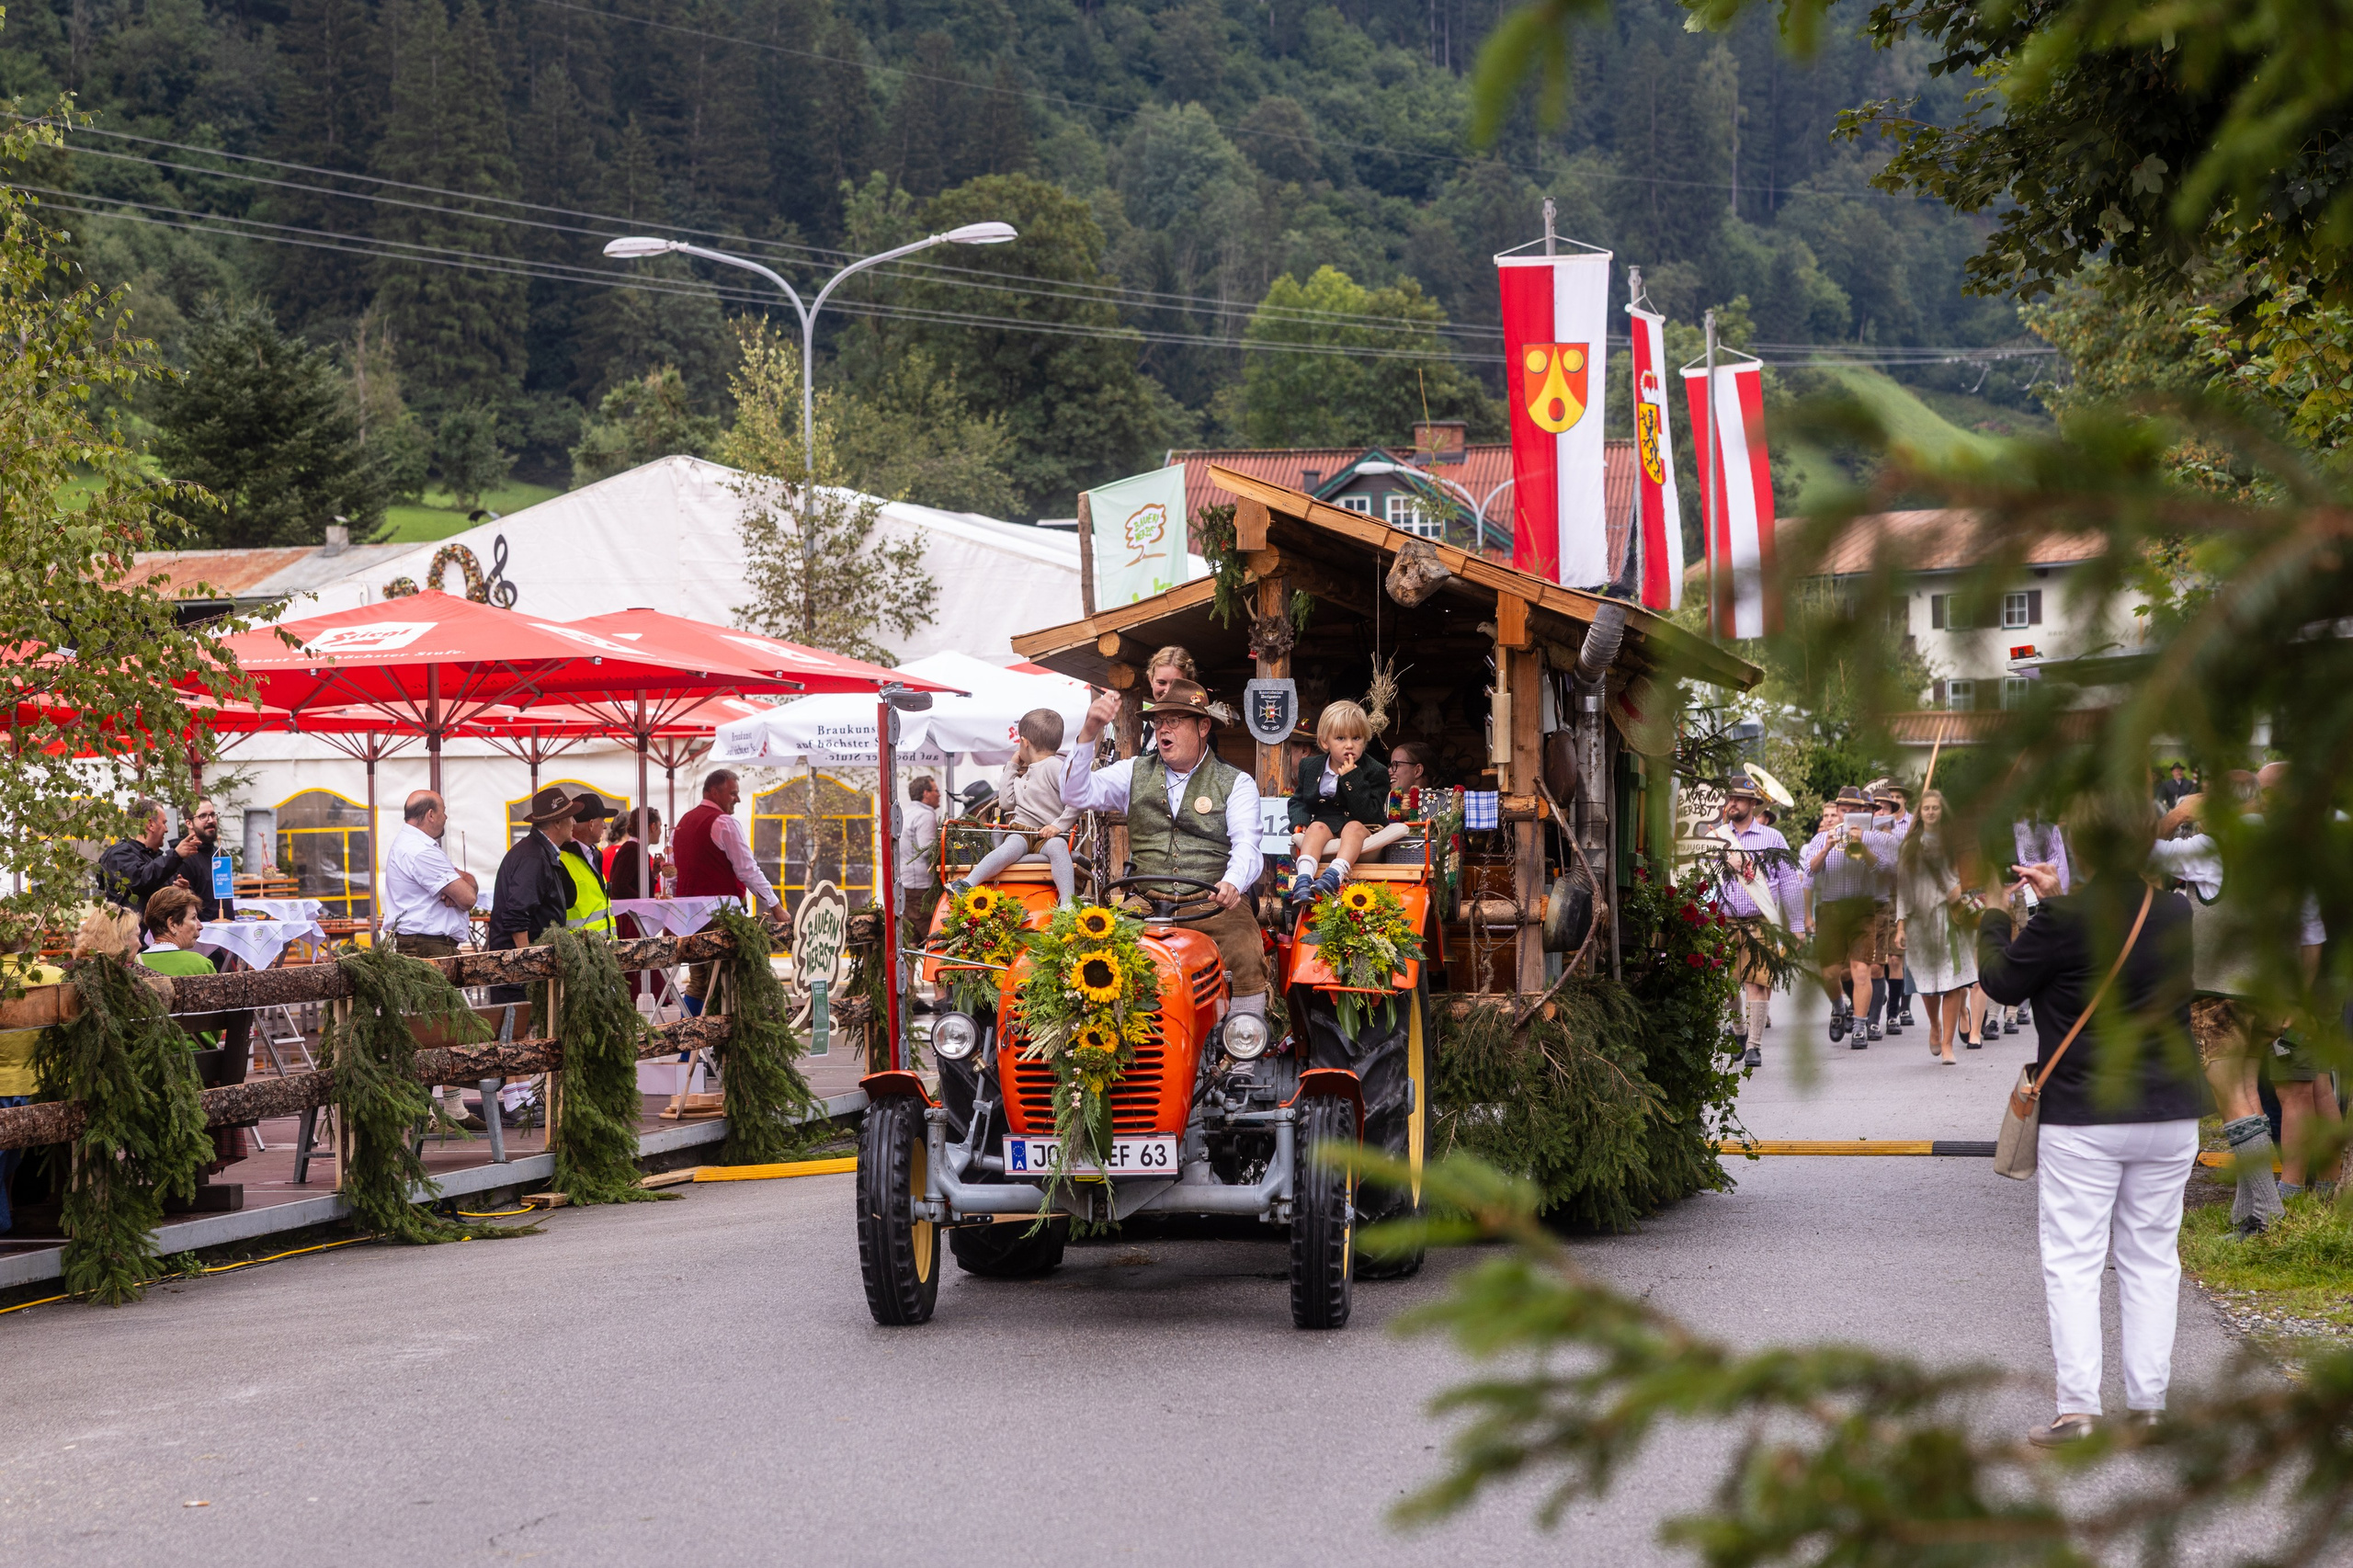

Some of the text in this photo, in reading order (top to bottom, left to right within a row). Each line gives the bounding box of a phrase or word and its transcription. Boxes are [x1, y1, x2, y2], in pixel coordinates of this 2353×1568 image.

[817, 725, 879, 735] Braukuns
[796, 740, 813, 749] auf
[818, 739, 870, 748] höchster
[1264, 814, 1291, 835] 12
[806, 908, 840, 949] BAUERN
[806, 941, 835, 977] HERBST
[1016, 1160, 1024, 1169] A
[1140, 1143, 1167, 1167] 63
